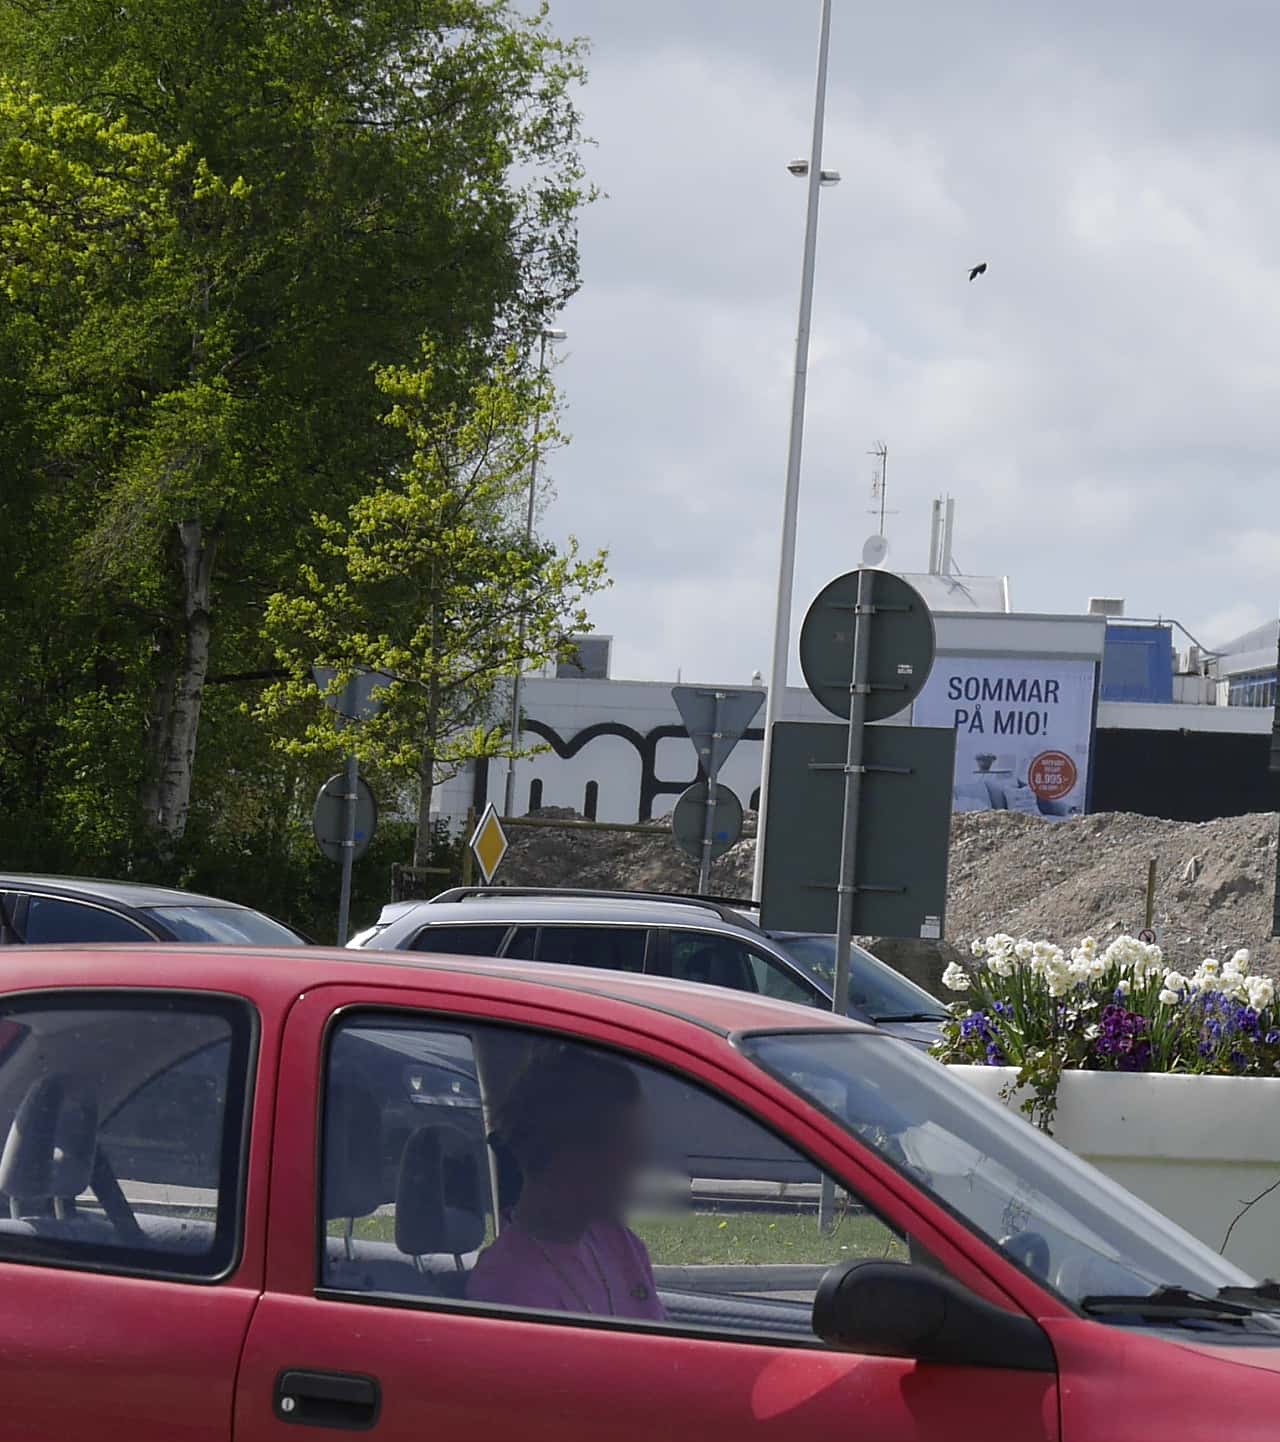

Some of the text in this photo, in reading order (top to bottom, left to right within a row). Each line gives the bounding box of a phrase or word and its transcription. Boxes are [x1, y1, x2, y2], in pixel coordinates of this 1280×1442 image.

[948, 676, 1059, 703] SOMMAR
[954, 704, 1048, 736] PÅ MIO!
